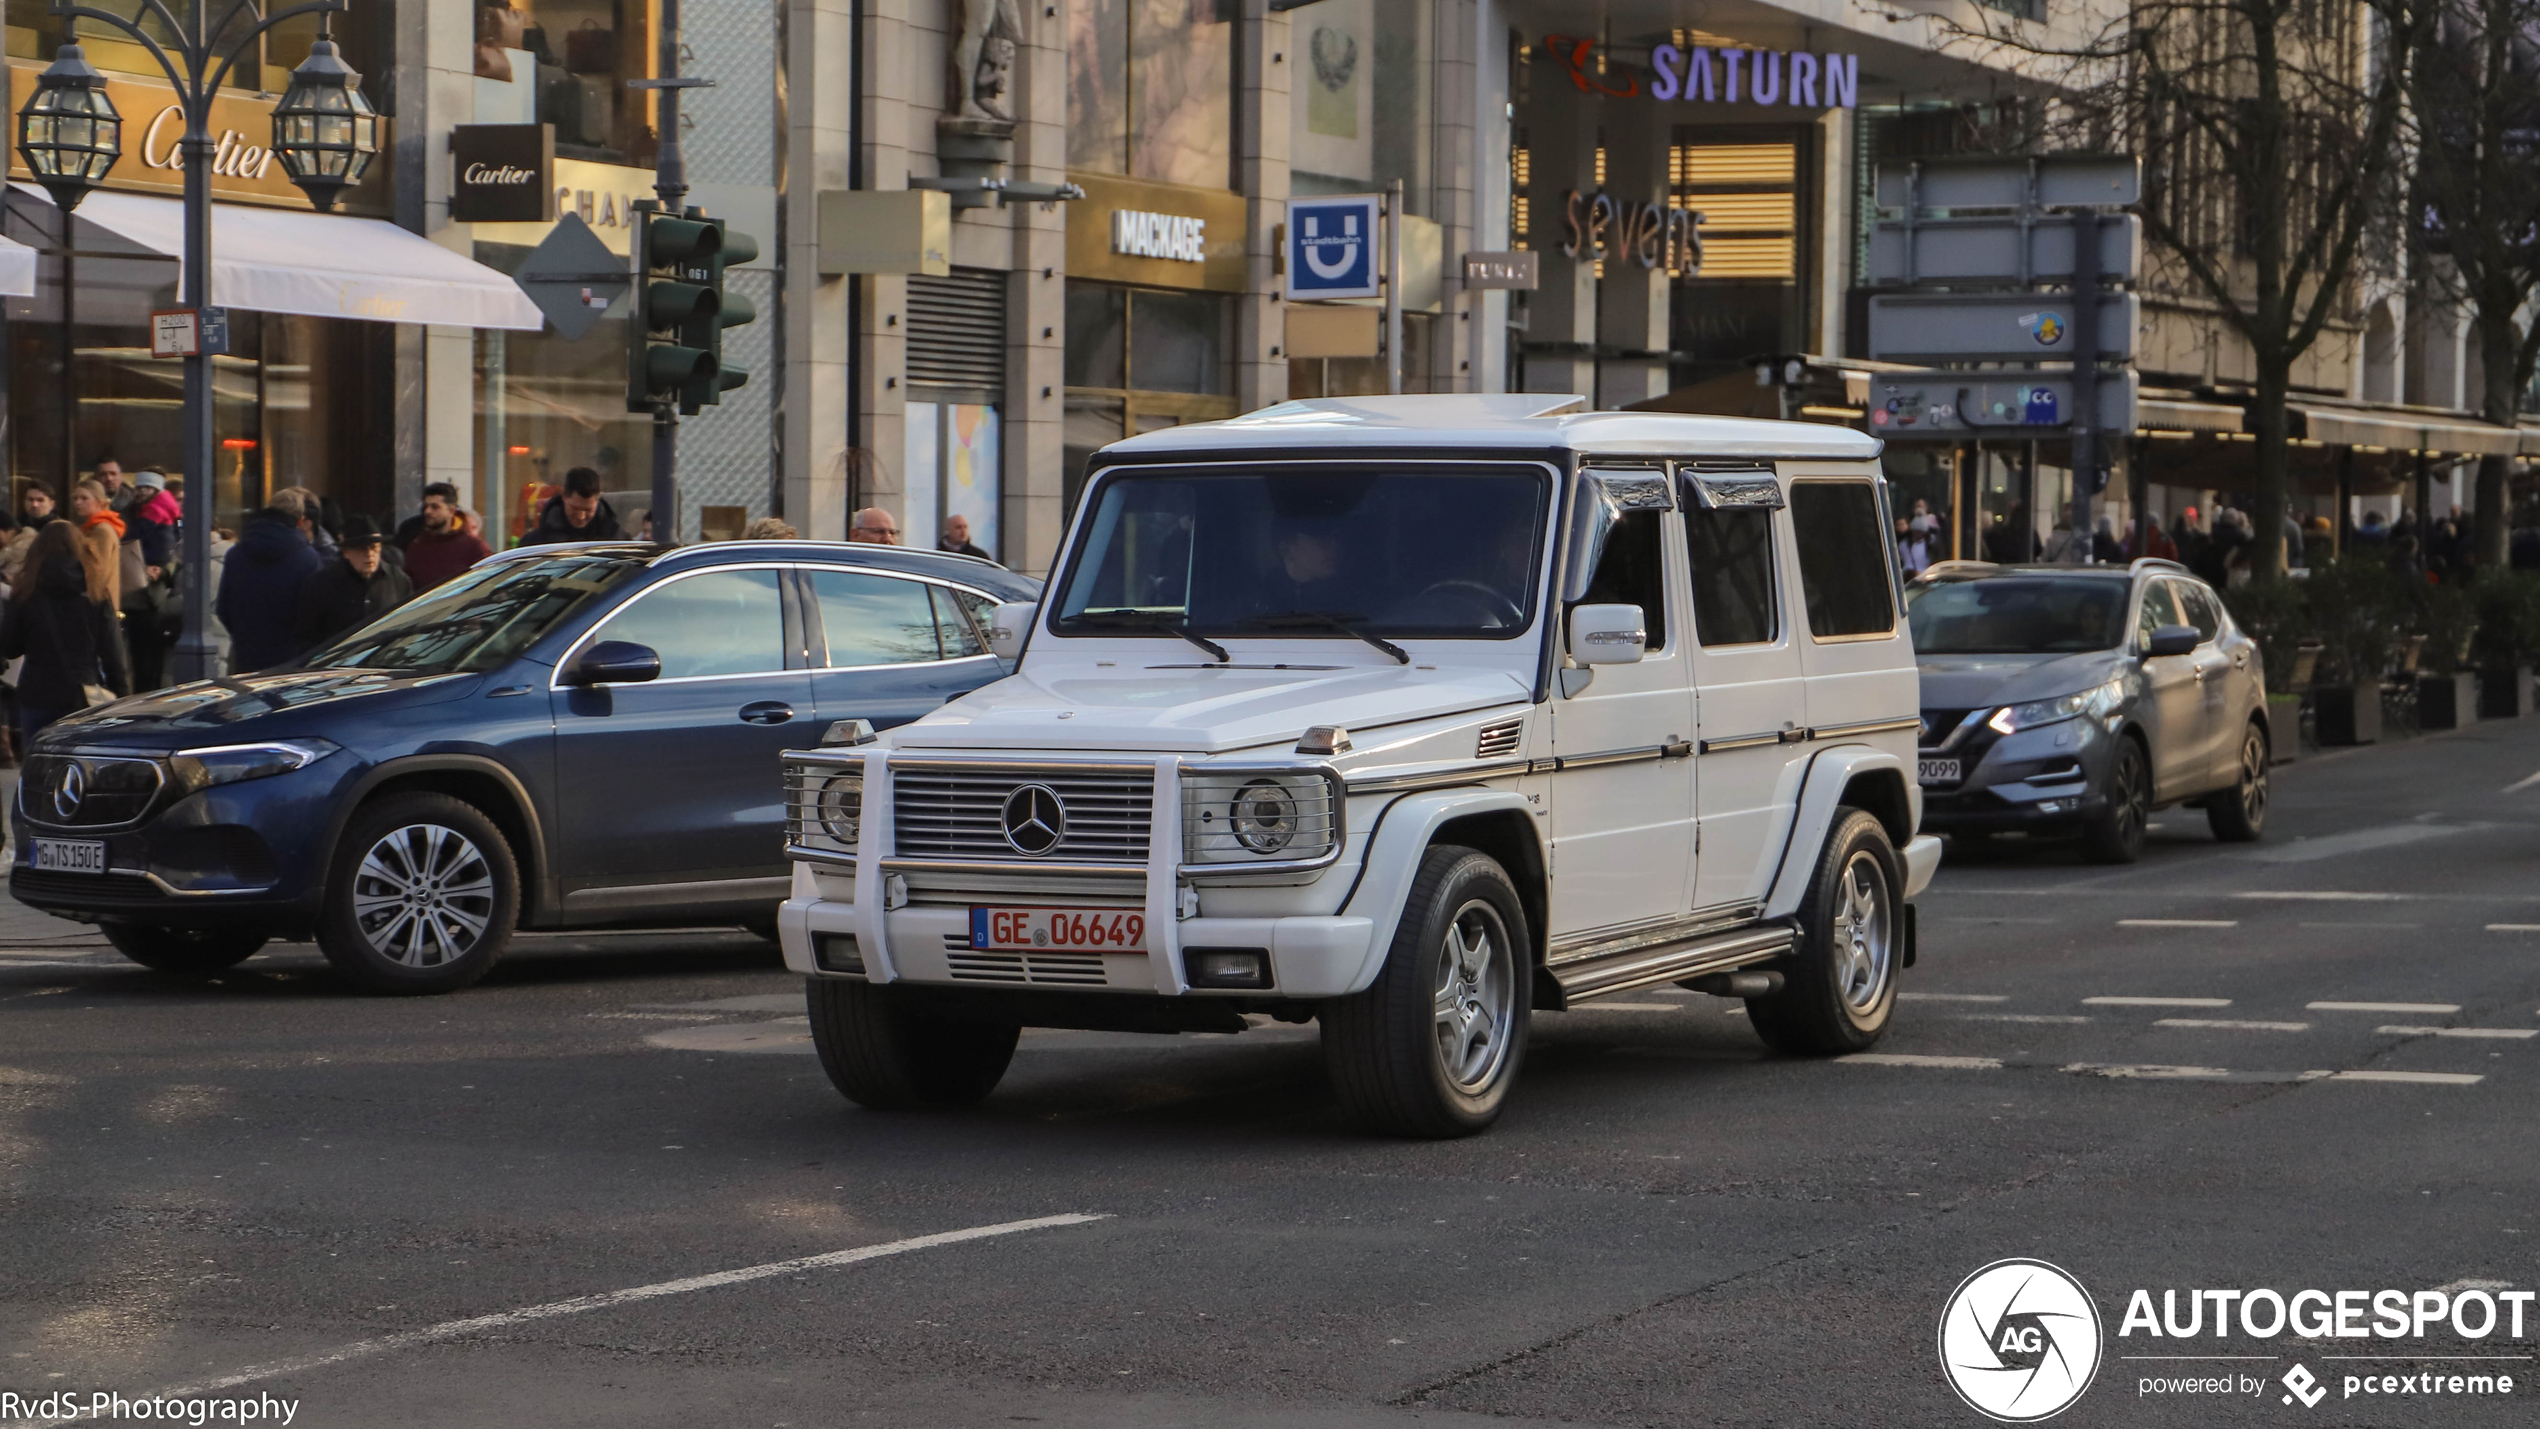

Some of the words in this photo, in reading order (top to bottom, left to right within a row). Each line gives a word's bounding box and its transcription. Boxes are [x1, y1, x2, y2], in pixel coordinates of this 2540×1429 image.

[1651, 44, 1858, 108] SATURN
[143, 104, 275, 179] Catier
[464, 162, 536, 185] Cartier
[1115, 209, 1205, 262] MACKAGE
[1300, 236, 1362, 246] stadtbahn
[688, 268, 708, 280] 061
[161, 314, 186, 326] H200
[1918, 760, 1958, 778] 9099
[55, 843, 69, 867] TS
[977, 932, 984, 942] D
[993, 912, 1032, 943] GE
[1050, 913, 1144, 947] 06649
